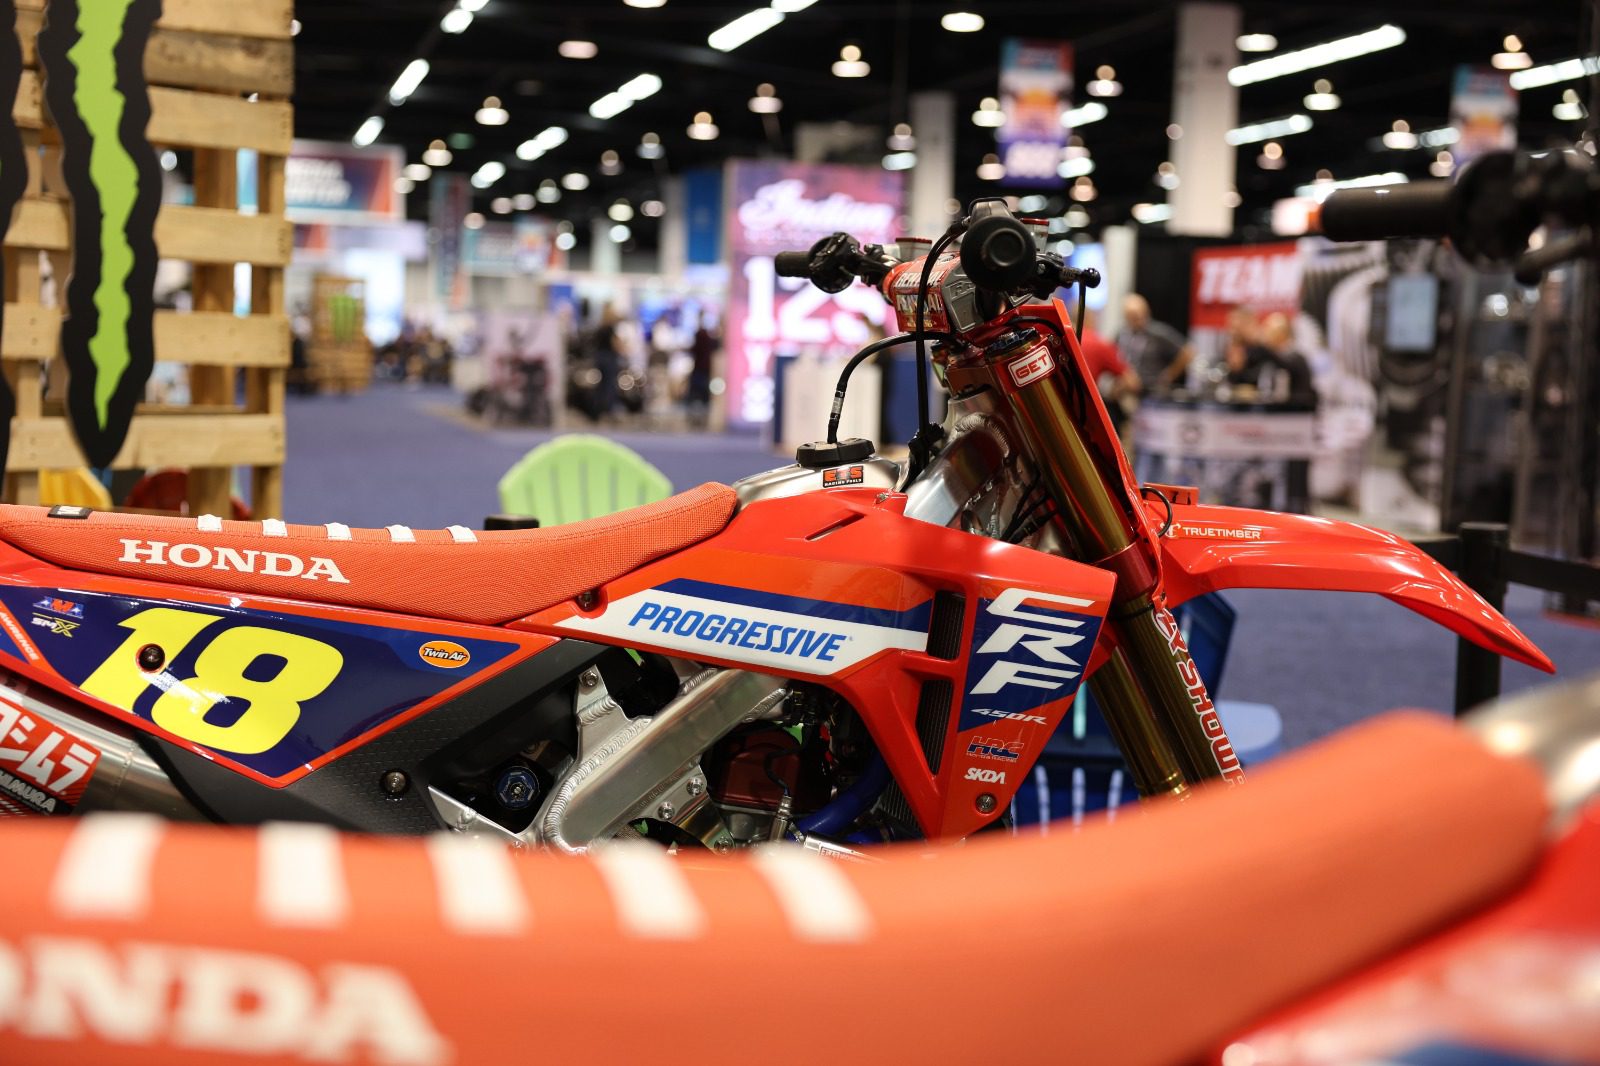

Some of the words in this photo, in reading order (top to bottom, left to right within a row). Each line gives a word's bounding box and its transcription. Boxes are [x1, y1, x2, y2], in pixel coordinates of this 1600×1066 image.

[1015, 353, 1048, 379] GET
[824, 467, 862, 482] ETS
[1182, 527, 1262, 539] TRUETIMBER
[118, 538, 350, 584] HONDA
[627, 601, 847, 662] PROGRESSIVE
[968, 587, 1096, 695] CRF
[424, 646, 449, 660] Twin
[448, 651, 467, 662] Air
[81, 607, 344, 755] 18
[970, 708, 1048, 726] 450R
[967, 735, 1025, 760] HRC
[964, 767, 1006, 785] SKDA
